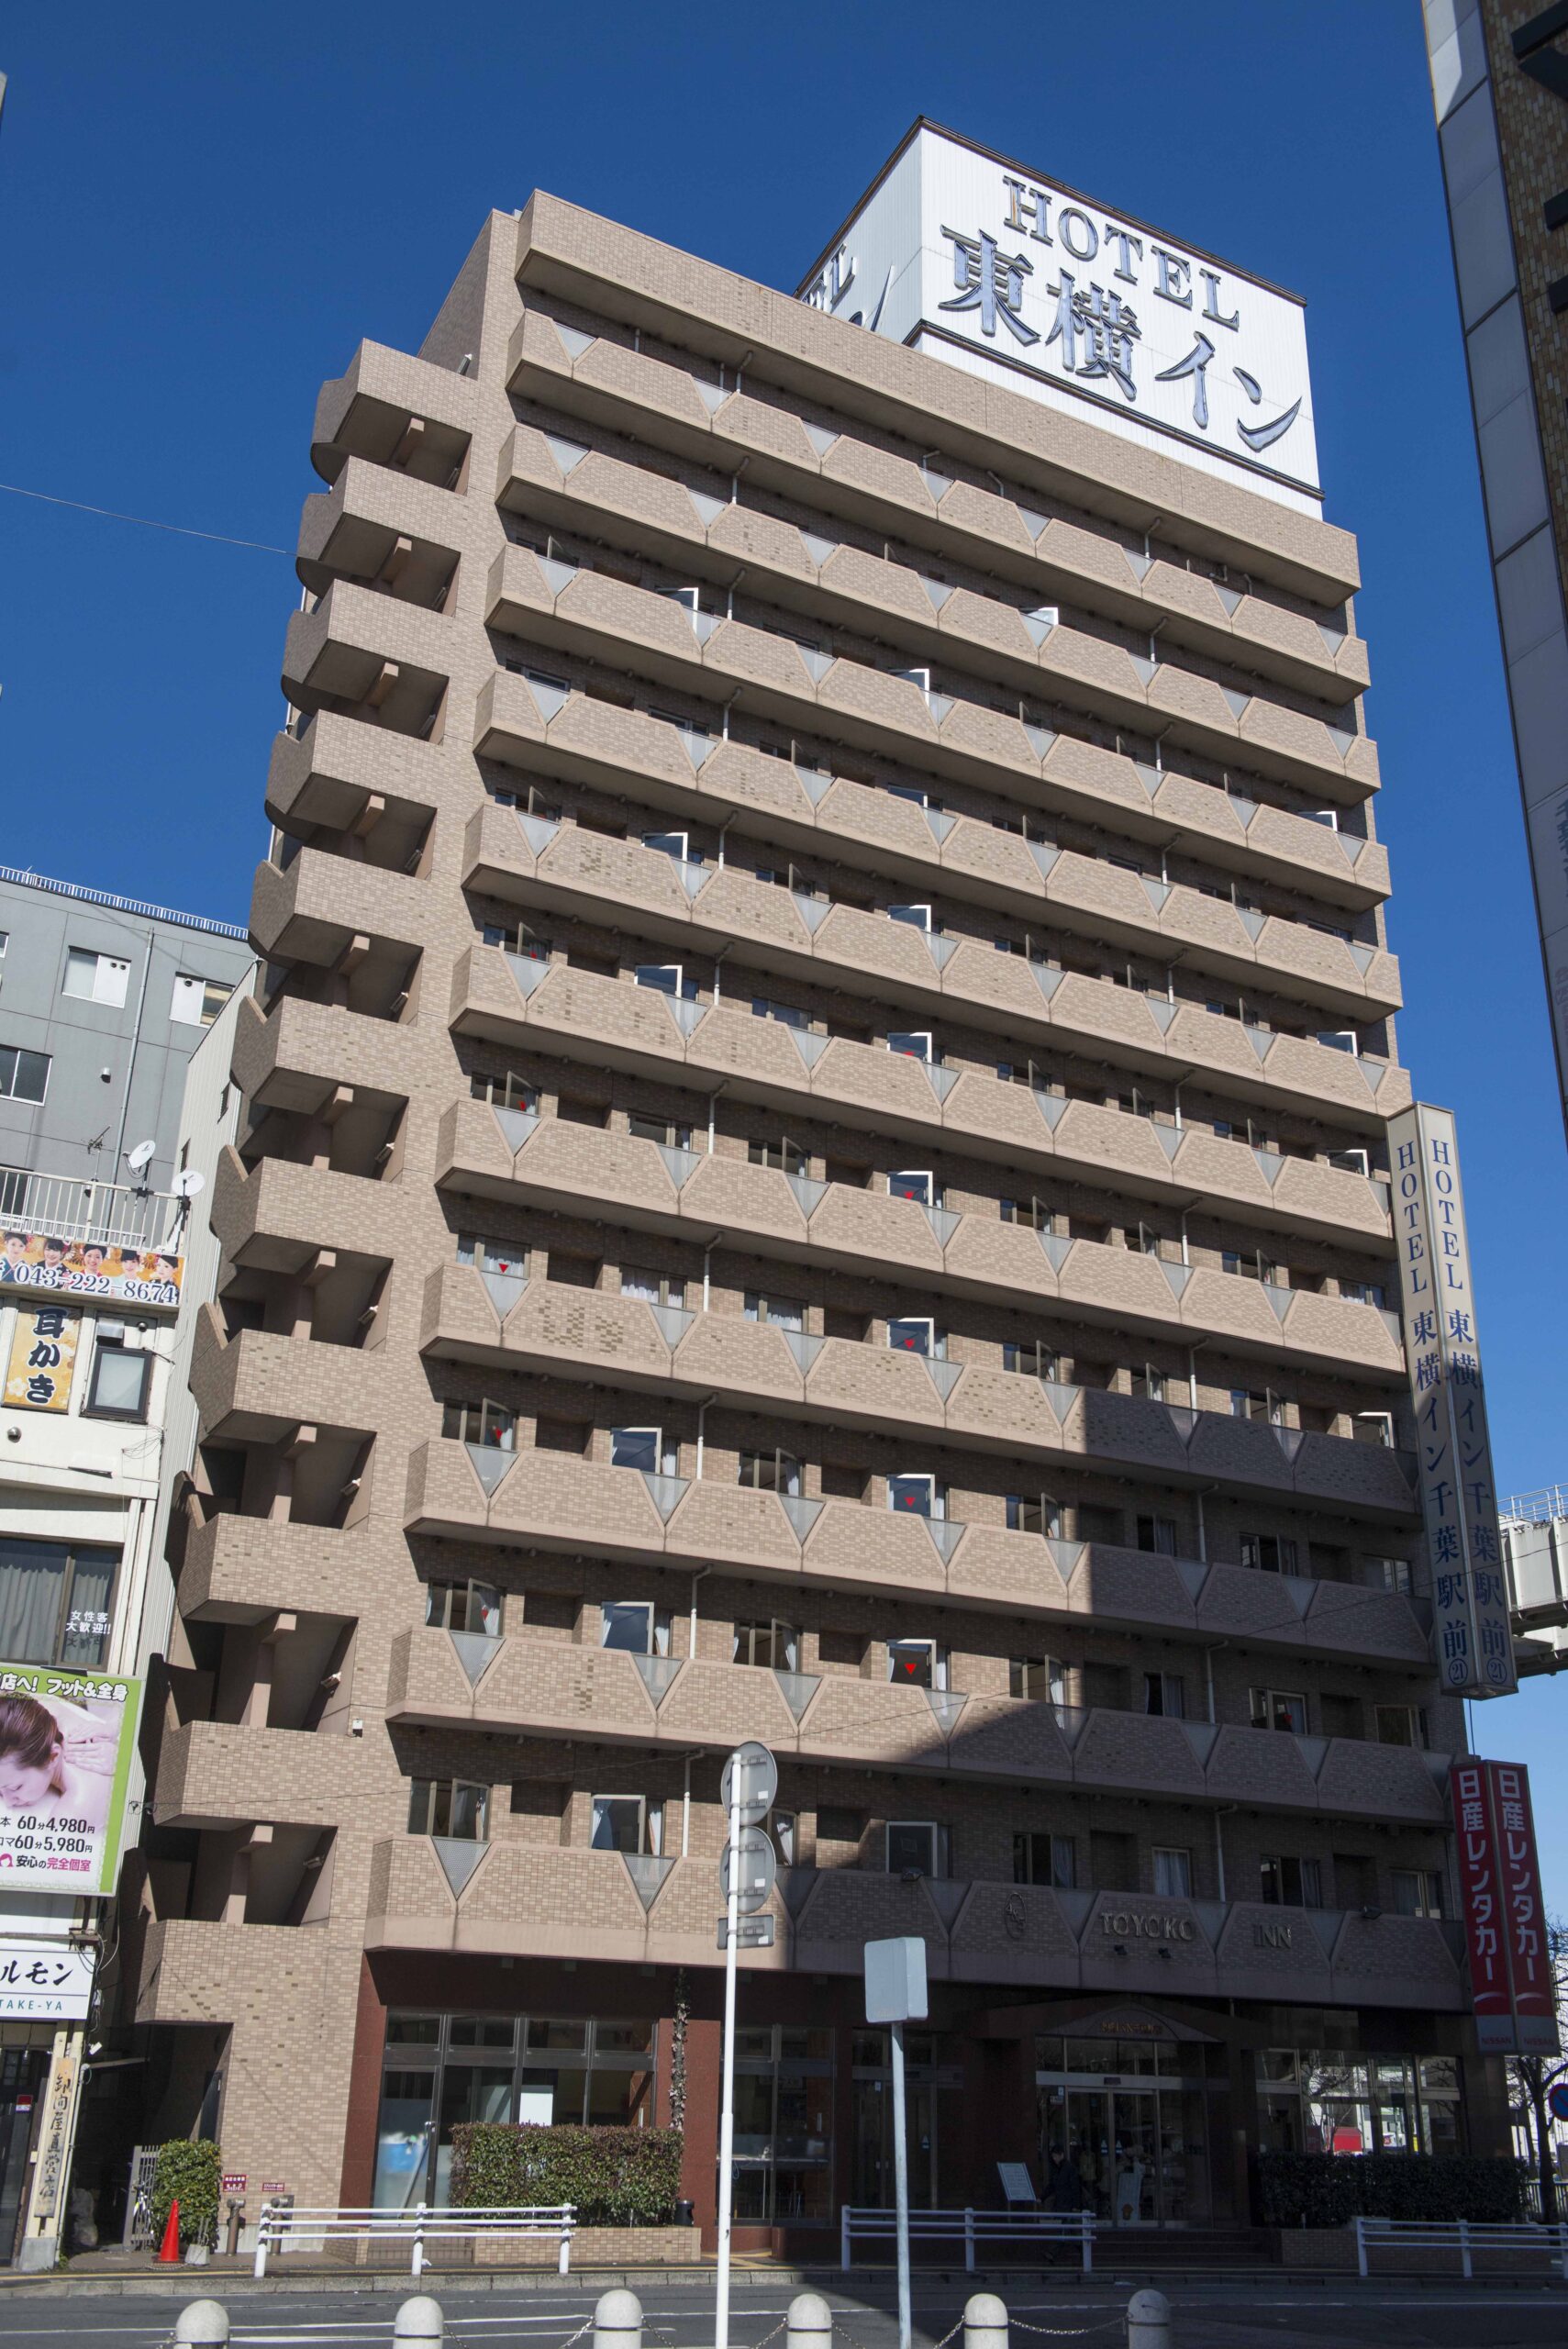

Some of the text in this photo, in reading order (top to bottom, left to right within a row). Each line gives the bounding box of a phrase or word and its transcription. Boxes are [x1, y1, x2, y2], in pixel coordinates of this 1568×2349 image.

[1003, 174, 1240, 333] HOTEL
[938, 224, 1303, 453] 東横イン
[15, 1263, 177, 1306] 043-222-8674
[1396, 1140, 1428, 1295] HOTEL
[1430, 1138, 1463, 1291] HOTEL
[26, 1307, 69, 1405] 耳かき
[71, 1609, 108, 1623] 女性客
[16, 1854, 92, 1872] 安心の完全個室
[1101, 1911, 1293, 1949] TOYOKO INN
[1459, 1769, 1497, 1982] 日産レンタカー
[1498, 1769, 1539, 1982] 日産レンタカー
